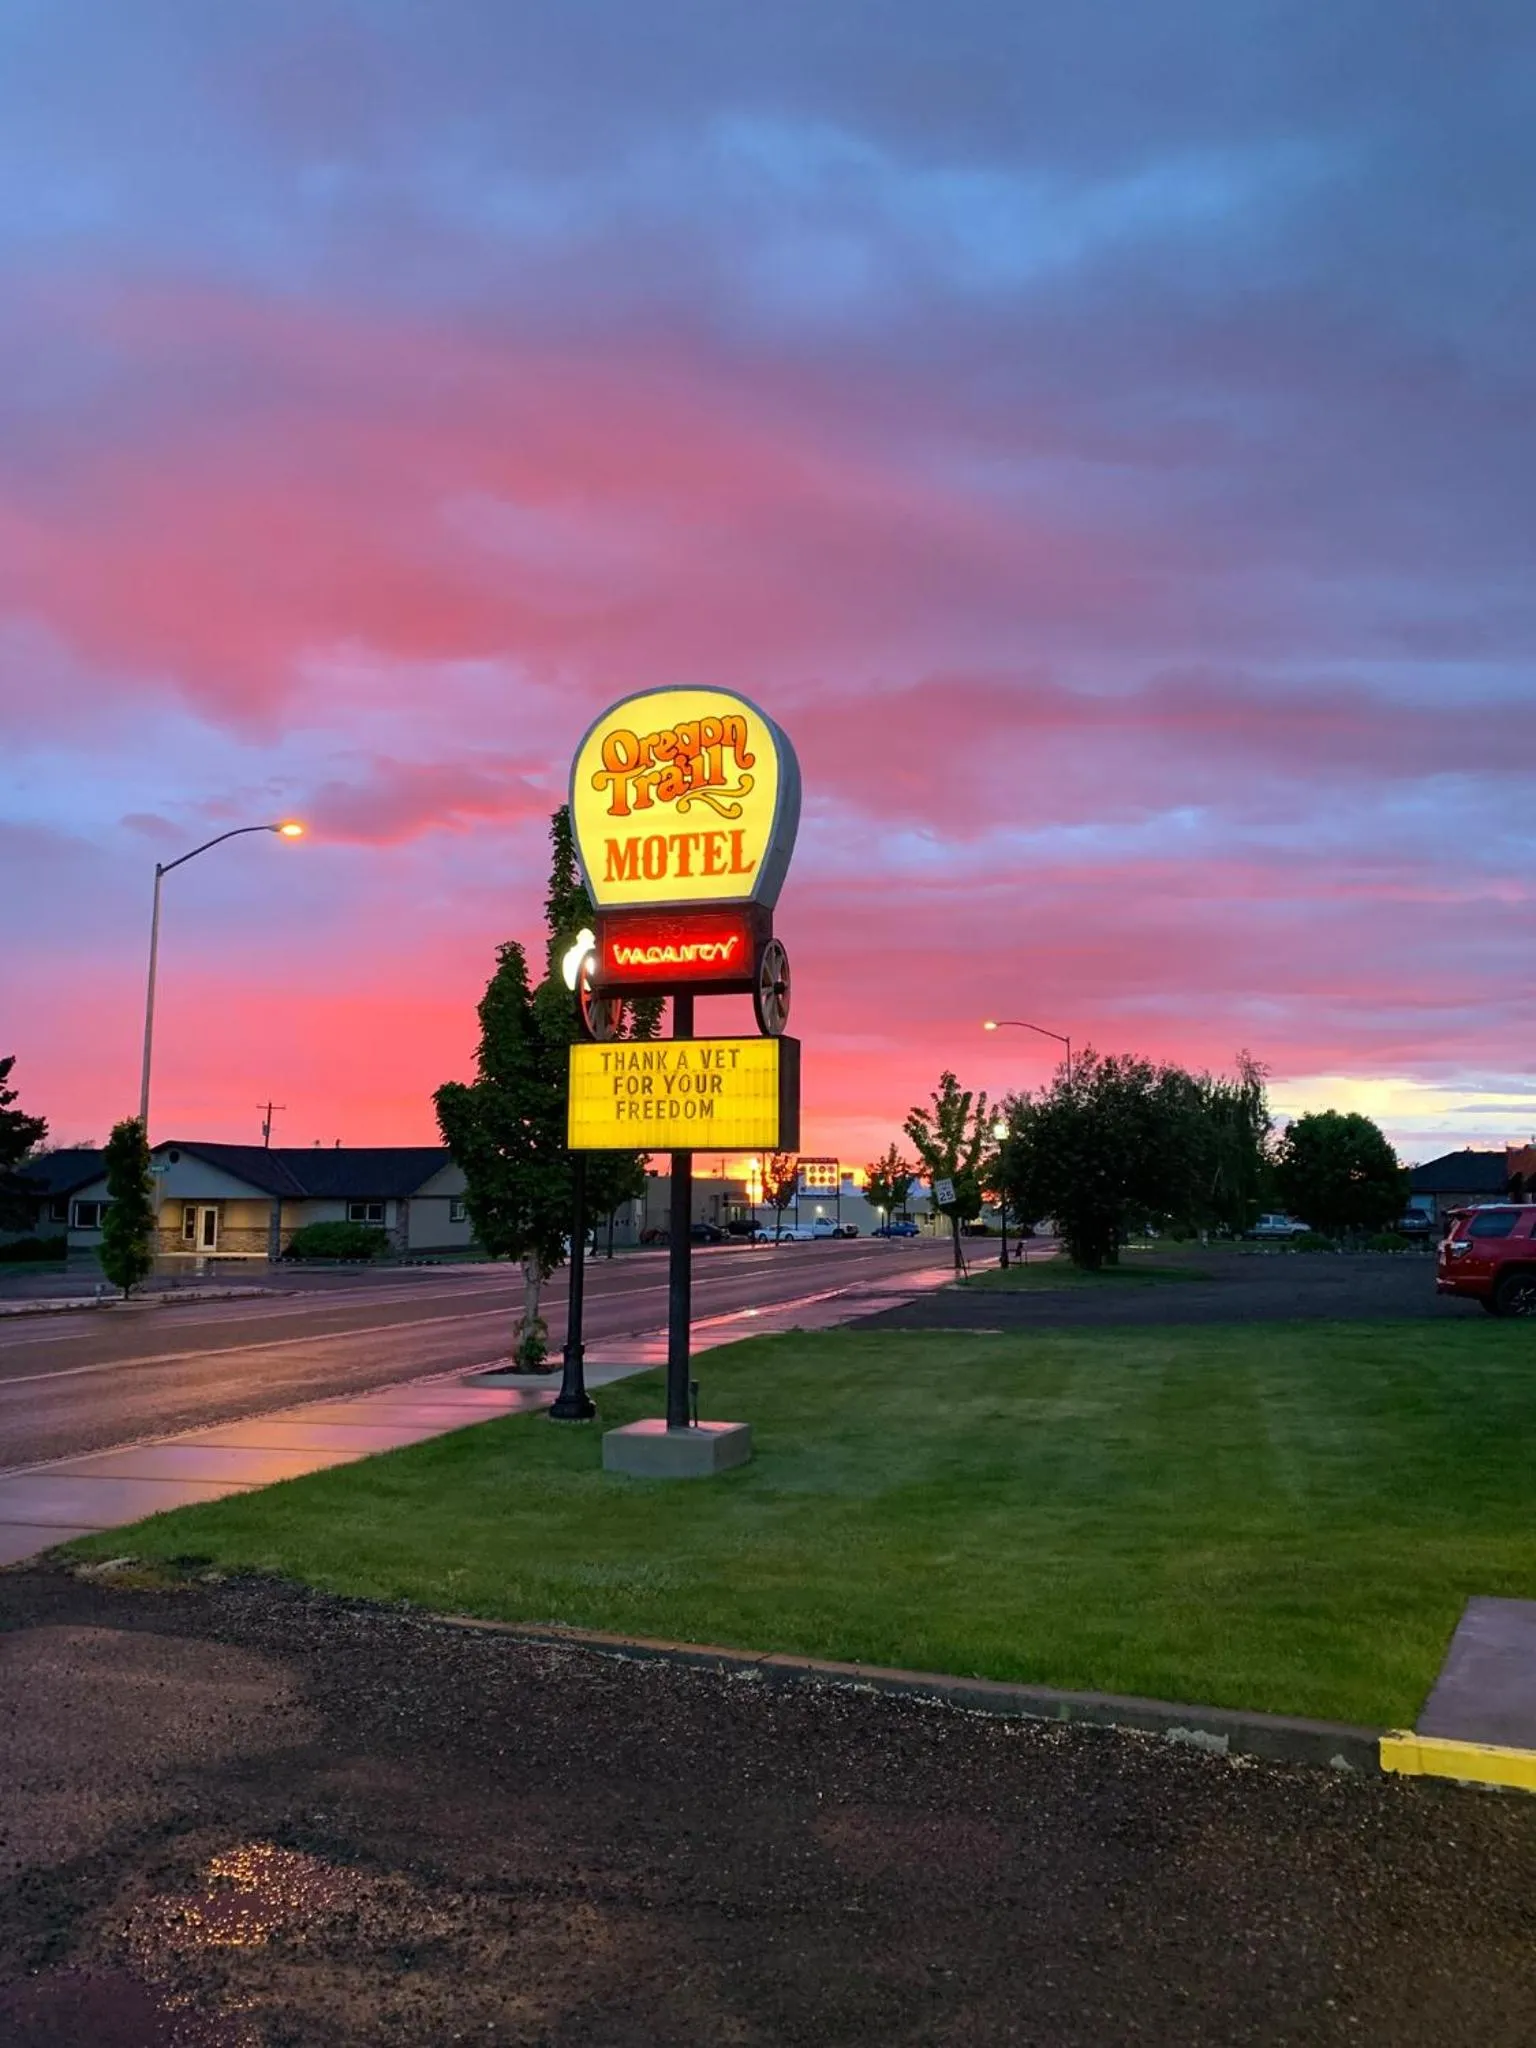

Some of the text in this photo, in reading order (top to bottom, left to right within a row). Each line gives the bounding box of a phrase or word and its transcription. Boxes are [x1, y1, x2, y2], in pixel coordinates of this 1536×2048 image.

[602, 715, 755, 772] Oregon
[591, 744, 733, 816] Trail
[603, 829, 756, 883] MOTEL
[613, 936, 739, 965] VACANCY
[601, 1048, 740, 1072] THANK A VET
[613, 1073, 722, 1095] FOR YOUR
[616, 1099, 714, 1120] FREEDOM
[939, 1191, 953, 1202] 25
